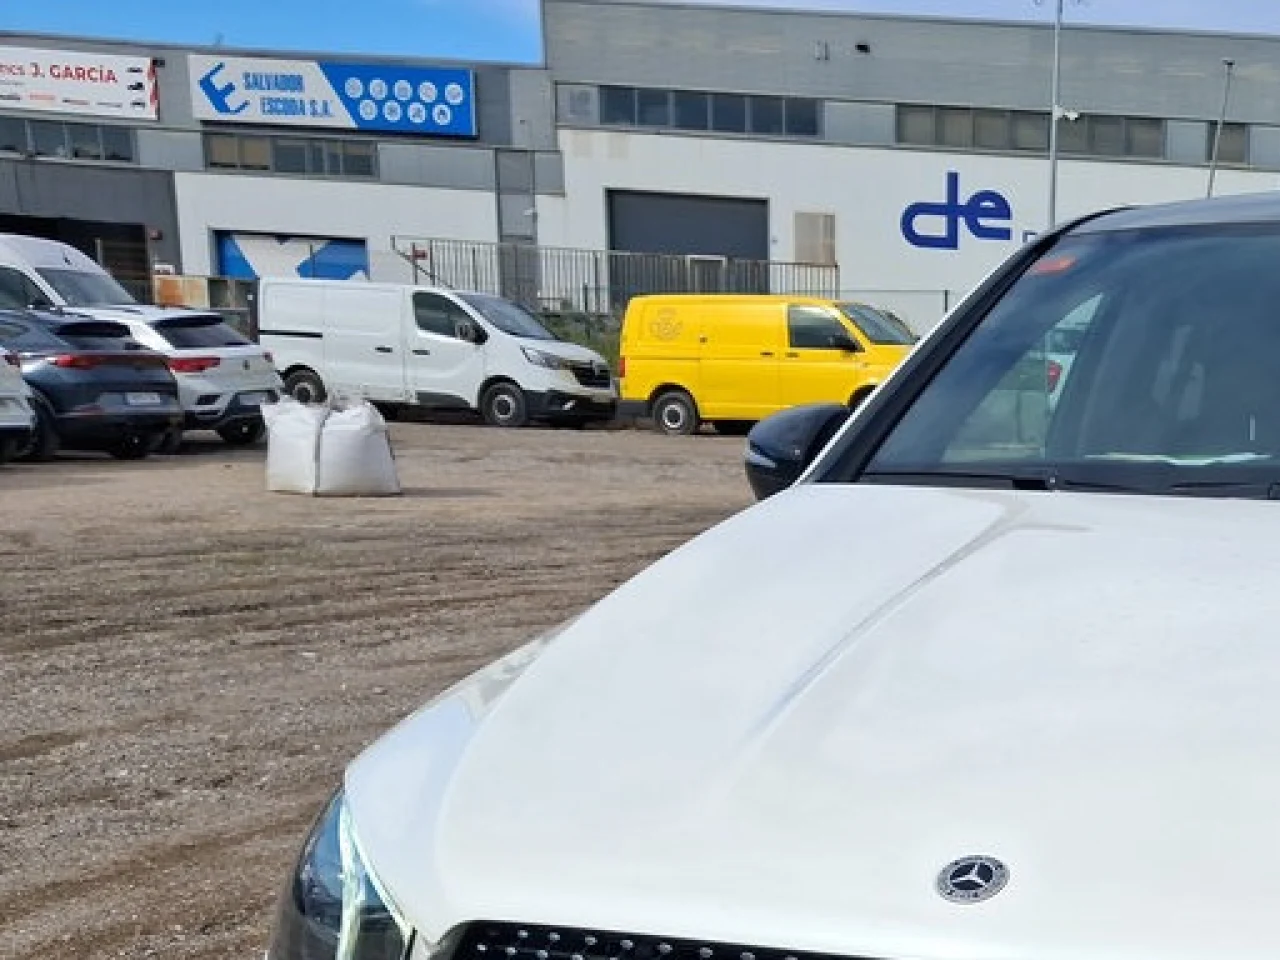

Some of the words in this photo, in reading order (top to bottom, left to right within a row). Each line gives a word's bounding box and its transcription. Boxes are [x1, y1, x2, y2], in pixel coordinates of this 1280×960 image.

[30, 62, 45, 78] J.
[50, 64, 118, 83] GARCÍA
[243, 72, 304, 92] SALVADOR
[260, 97, 306, 116] ESCODA
